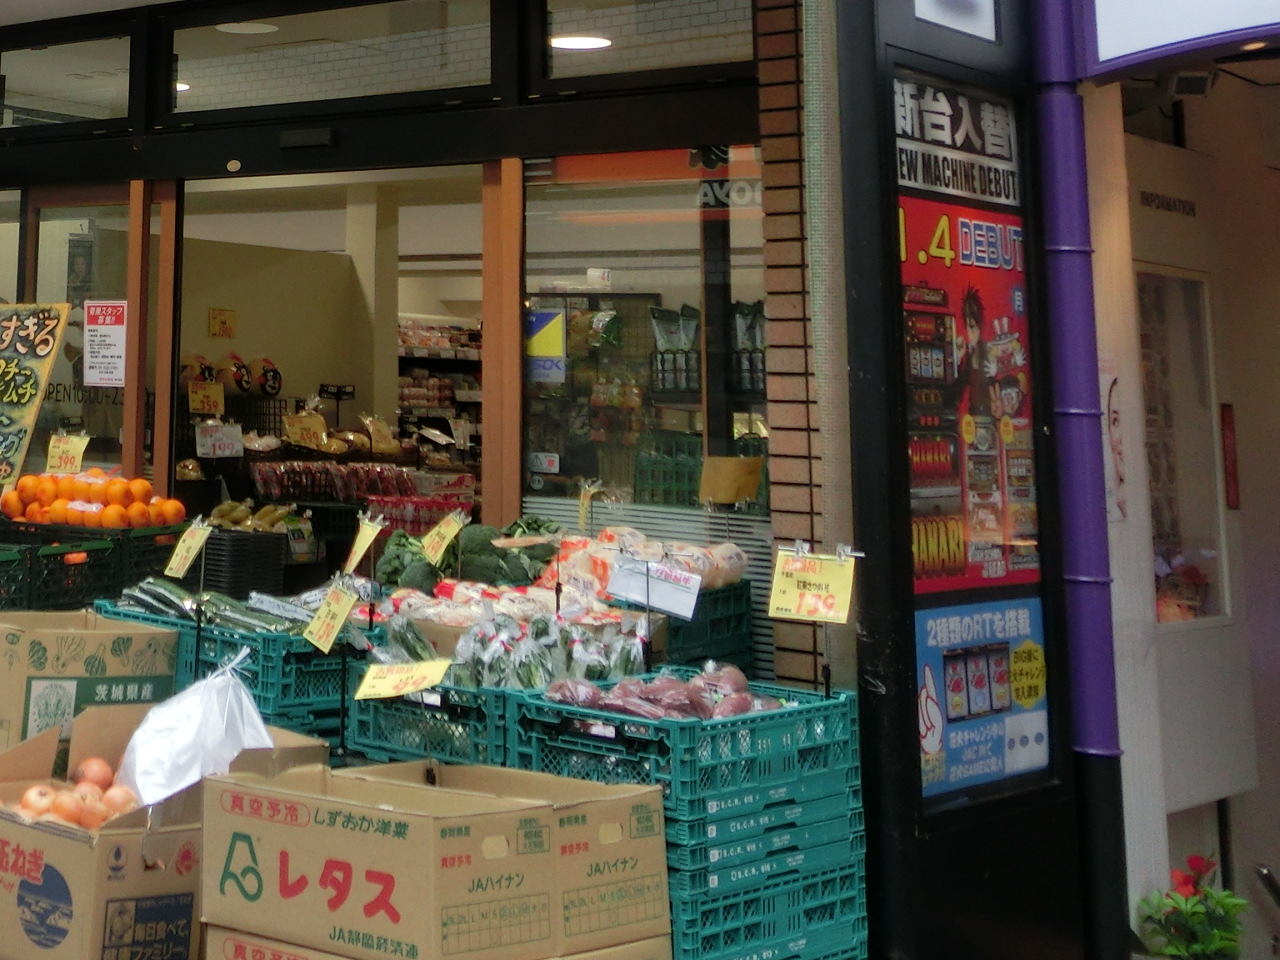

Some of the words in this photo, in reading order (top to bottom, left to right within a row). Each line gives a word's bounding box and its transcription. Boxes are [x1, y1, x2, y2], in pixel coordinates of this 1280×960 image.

[893, 79, 1014, 163] 新台入替
[898, 147, 918, 182] EW
[922, 151, 976, 194] MACHINE
[979, 166, 1017, 201] DEBUT
[958, 217, 1024, 272] DEBUT
[57, 455, 76, 470] 399
[95, 683, 154, 702] 茨城県産
[230, 794, 299, 823] 真空予冷
[586, 857, 639, 877] JAハイナン
[279, 849, 401, 925] レタス
[468, 873, 525, 893] JAハイナン
